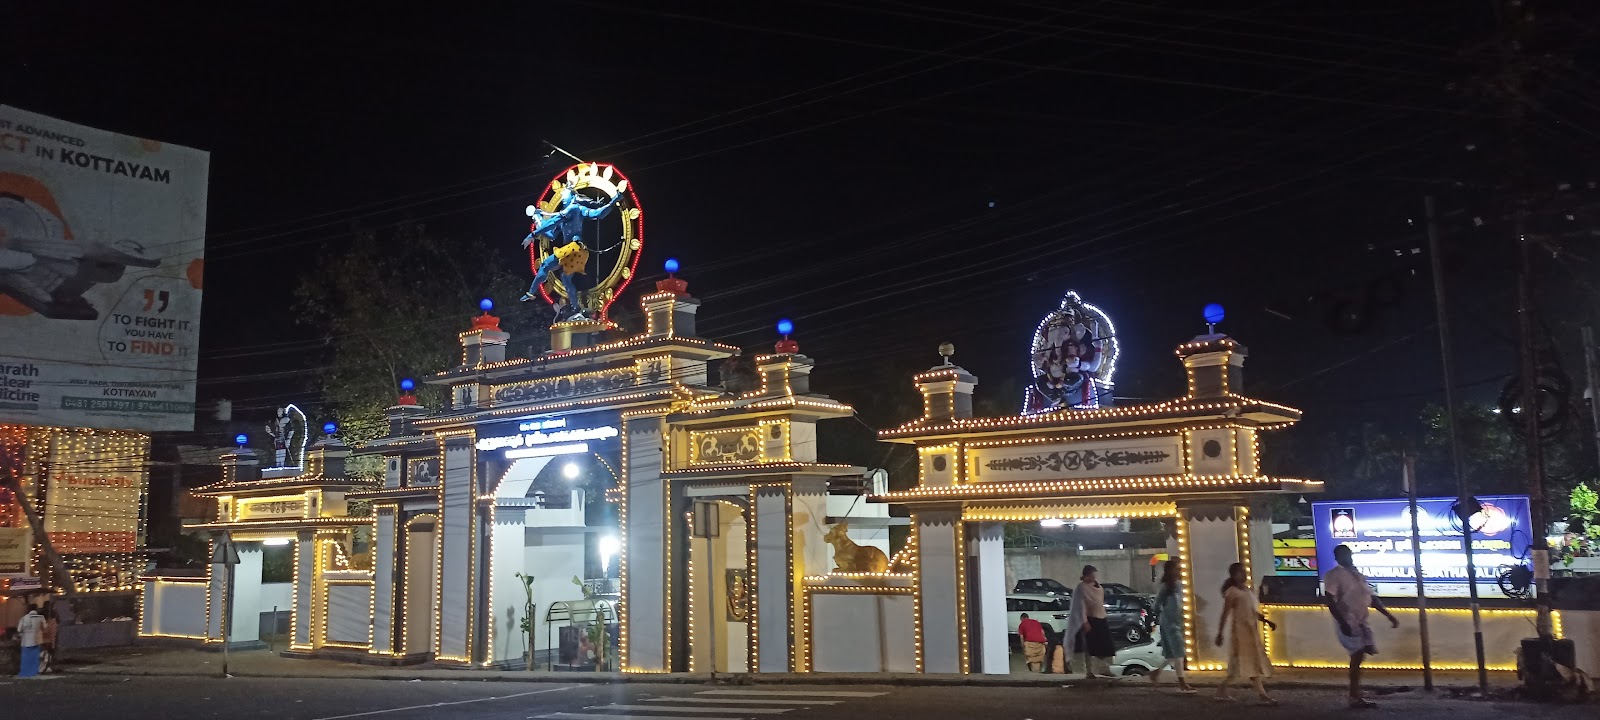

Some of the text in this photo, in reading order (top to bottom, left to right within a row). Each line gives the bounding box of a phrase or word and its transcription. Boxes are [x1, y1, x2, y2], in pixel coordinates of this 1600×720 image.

[16, 124, 86, 147] ADVANCED
[36, 145, 54, 160] IN
[60, 147, 171, 184] KOTTAYAM
[113, 314, 132, 325] TO
[135, 316, 176, 329] FIGHT
[125, 329, 174, 340] YOU HAVE
[108, 340, 191, 357] TO FIND IT
[103, 387, 157, 398] KOTTAYAM
